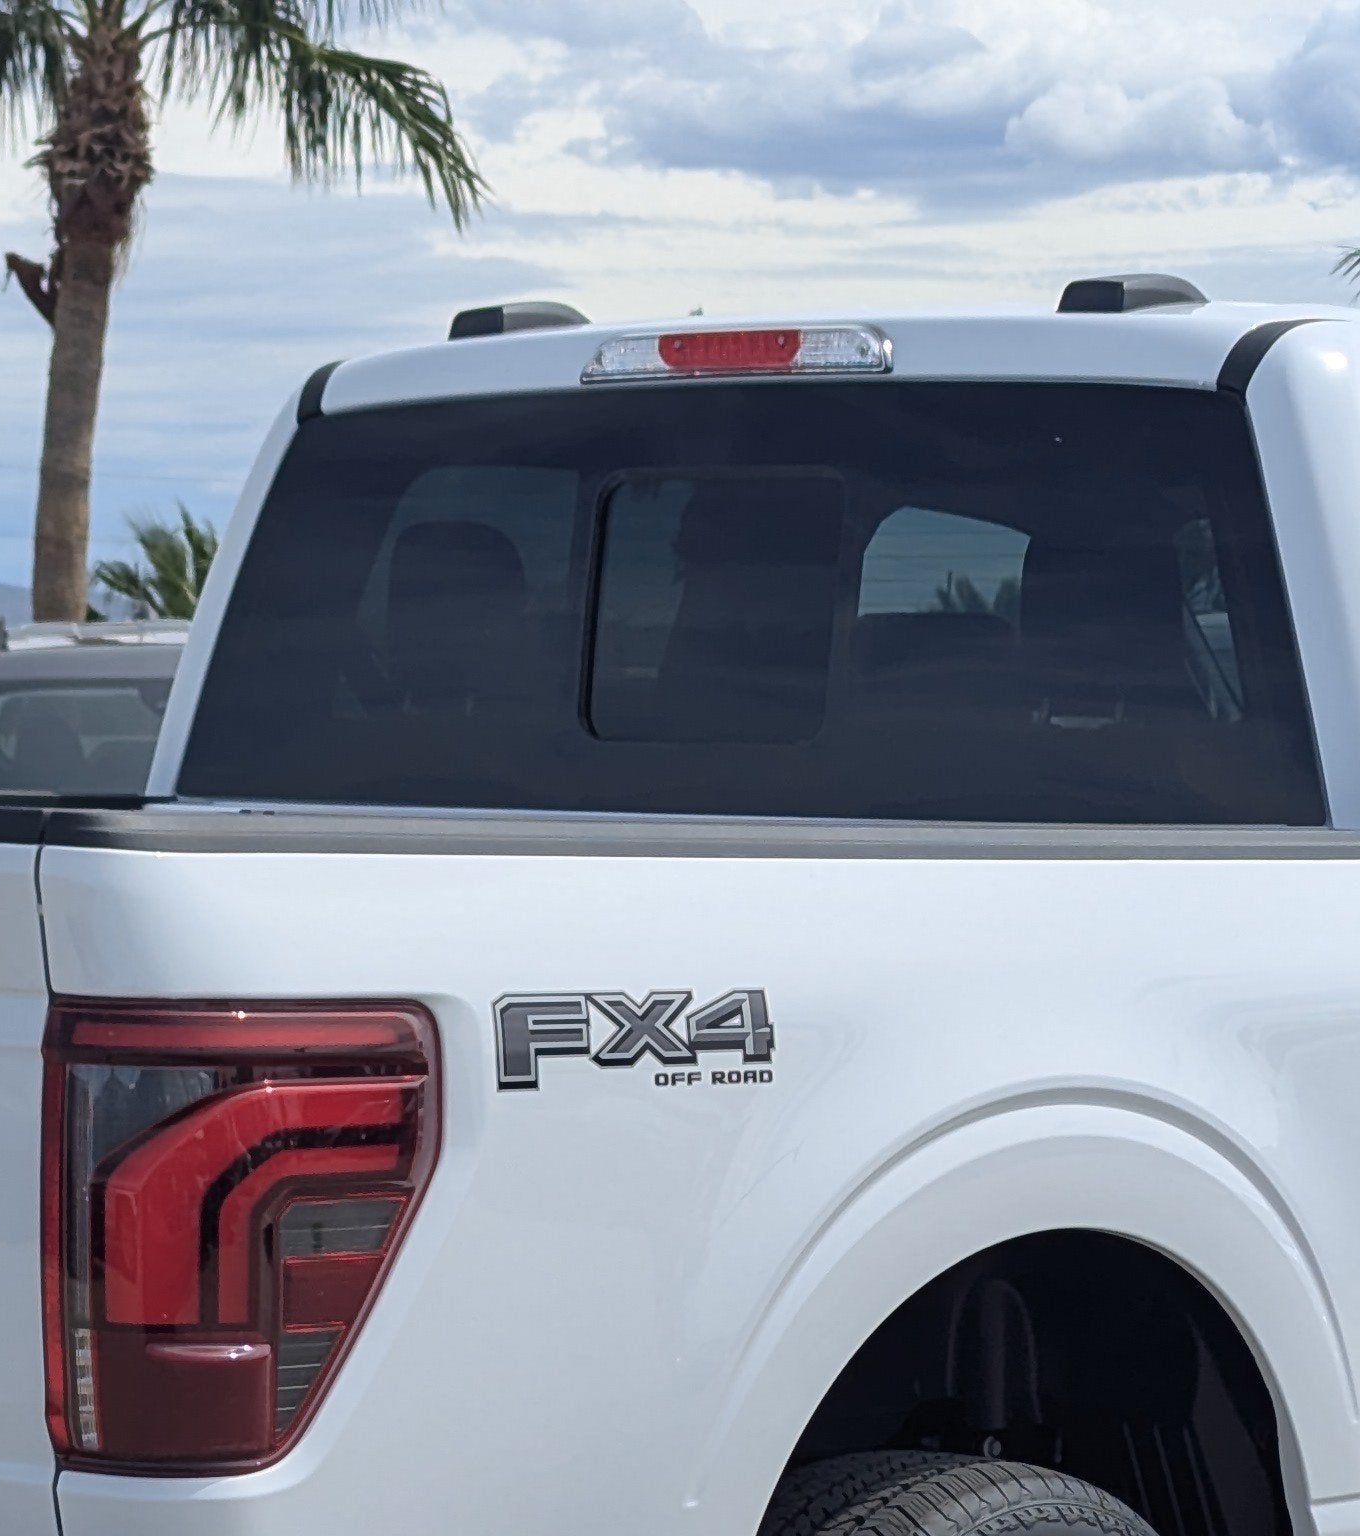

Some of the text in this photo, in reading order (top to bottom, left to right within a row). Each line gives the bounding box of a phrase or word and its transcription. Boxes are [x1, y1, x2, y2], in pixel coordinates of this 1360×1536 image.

[491, 987, 775, 1092] FX4
[654, 1069, 774, 1087] OFF ROAD
